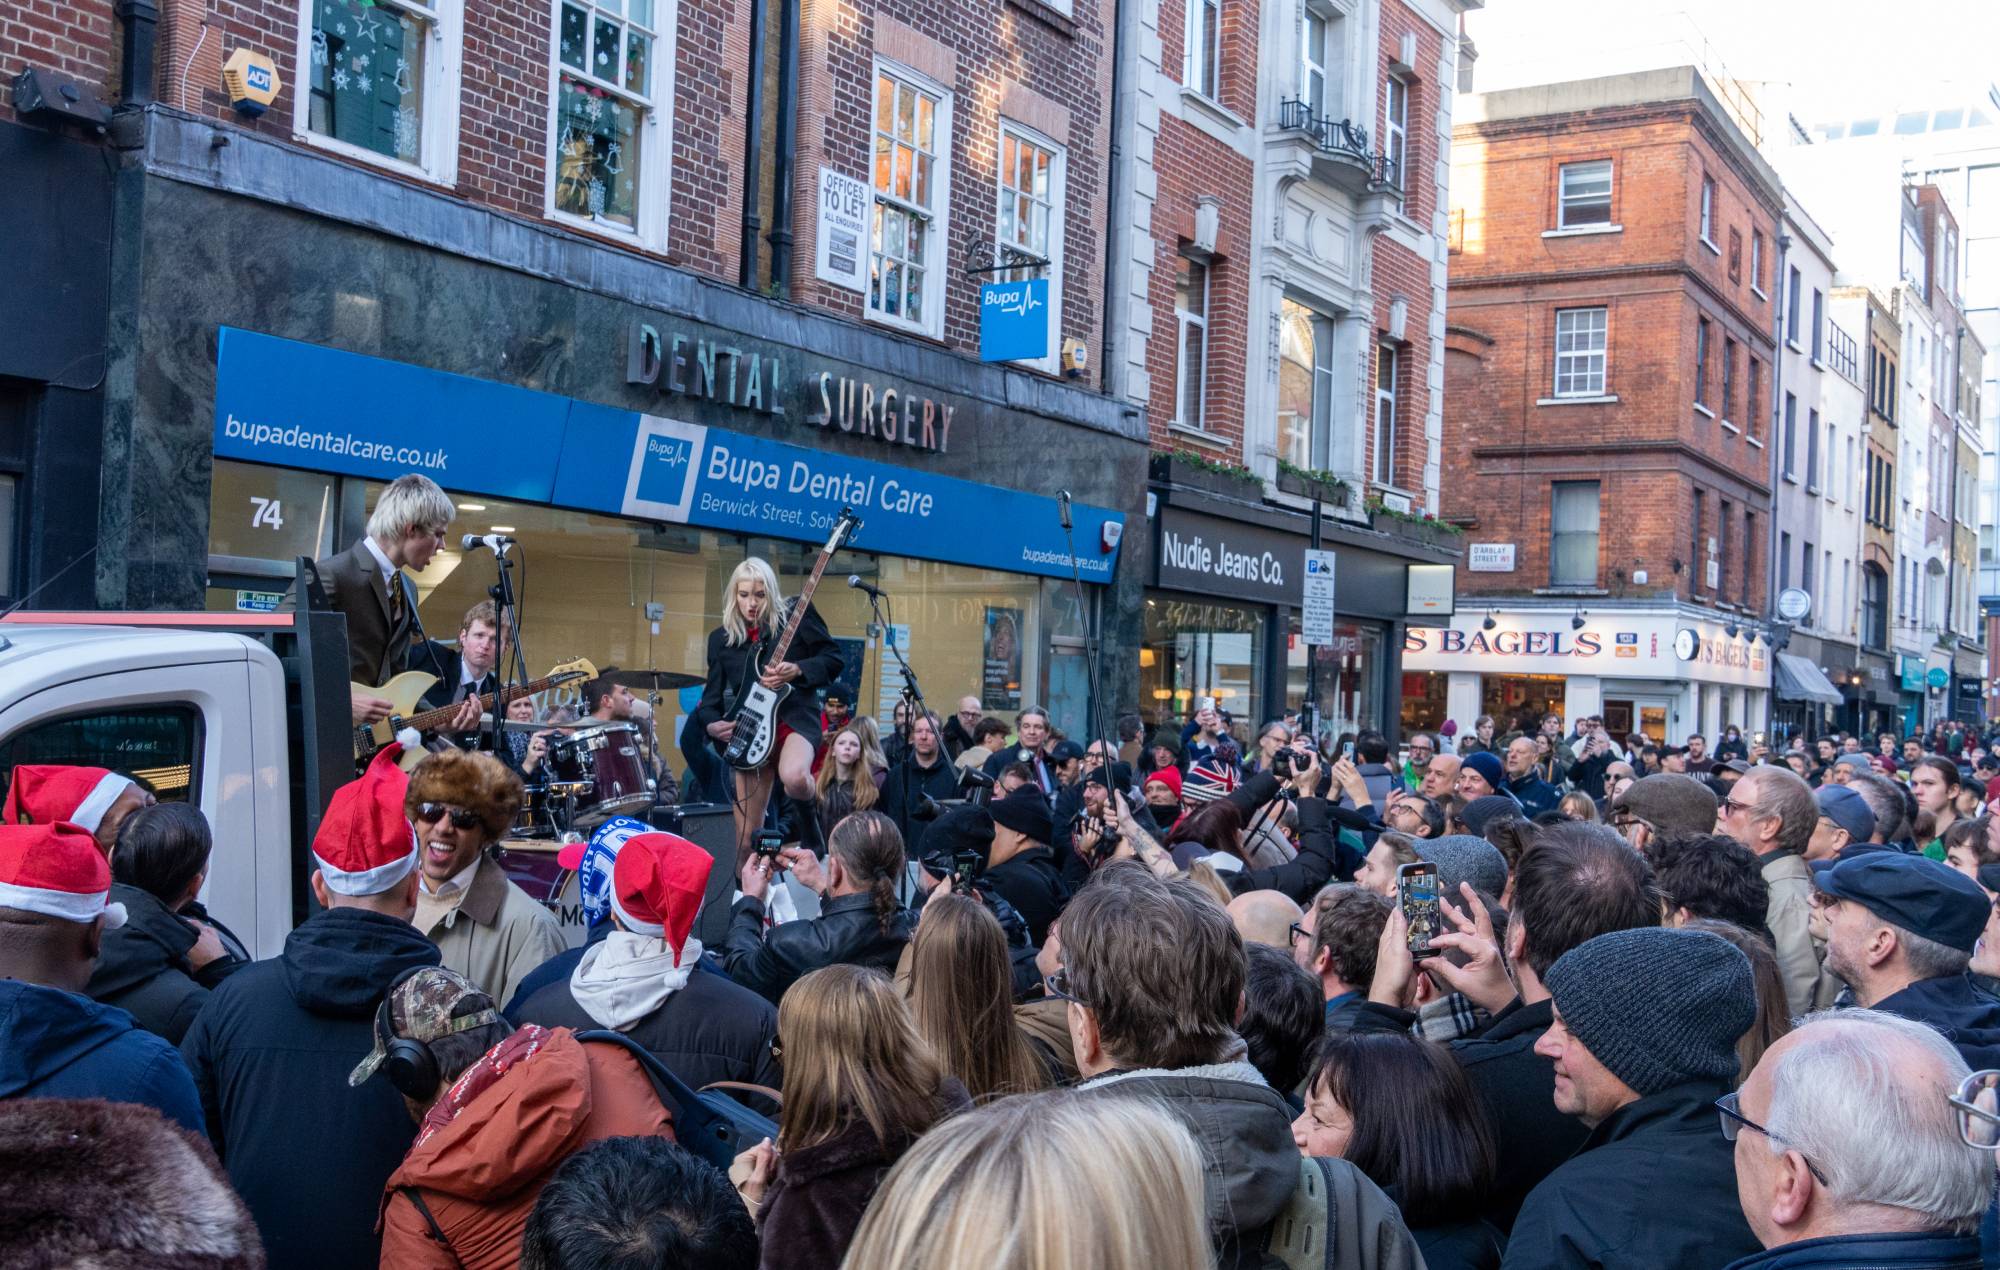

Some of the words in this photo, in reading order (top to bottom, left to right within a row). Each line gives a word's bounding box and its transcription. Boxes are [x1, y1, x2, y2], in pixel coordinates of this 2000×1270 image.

[248, 70, 271, 88] ADT
[826, 174, 864, 200] OFFICES
[824, 187, 840, 210] TO
[844, 195, 866, 220] LET
[825, 212, 834, 222] ALL
[836, 216, 863, 232] ENQUIRIES
[985, 291, 1020, 306] Bupa
[636, 324, 785, 415] DENTAL
[816, 371, 954, 453] SURGERY
[225, 414, 448, 470] bupadentalcare.co.uk
[648, 439, 674, 455] Bupa
[707, 445, 781, 492] Bupa
[789, 461, 875, 506] Dental
[880, 480, 934, 517] Care
[250, 496, 284, 530] 74
[701, 492, 758, 518] Berwick
[761, 502, 805, 528] Street,
[809, 511, 834, 529] Soh
[1163, 531, 1211, 573] Nudie
[1214, 542, 1259, 581] Jeans
[1261, 551, 1284, 586] Co.
[1473, 546, 1506, 554] D'ARBLAY
[1473, 555, 1498, 563] STREET
[1438, 630, 1603, 657] BAGELS
[1715, 641, 1750, 669] BAGELS
